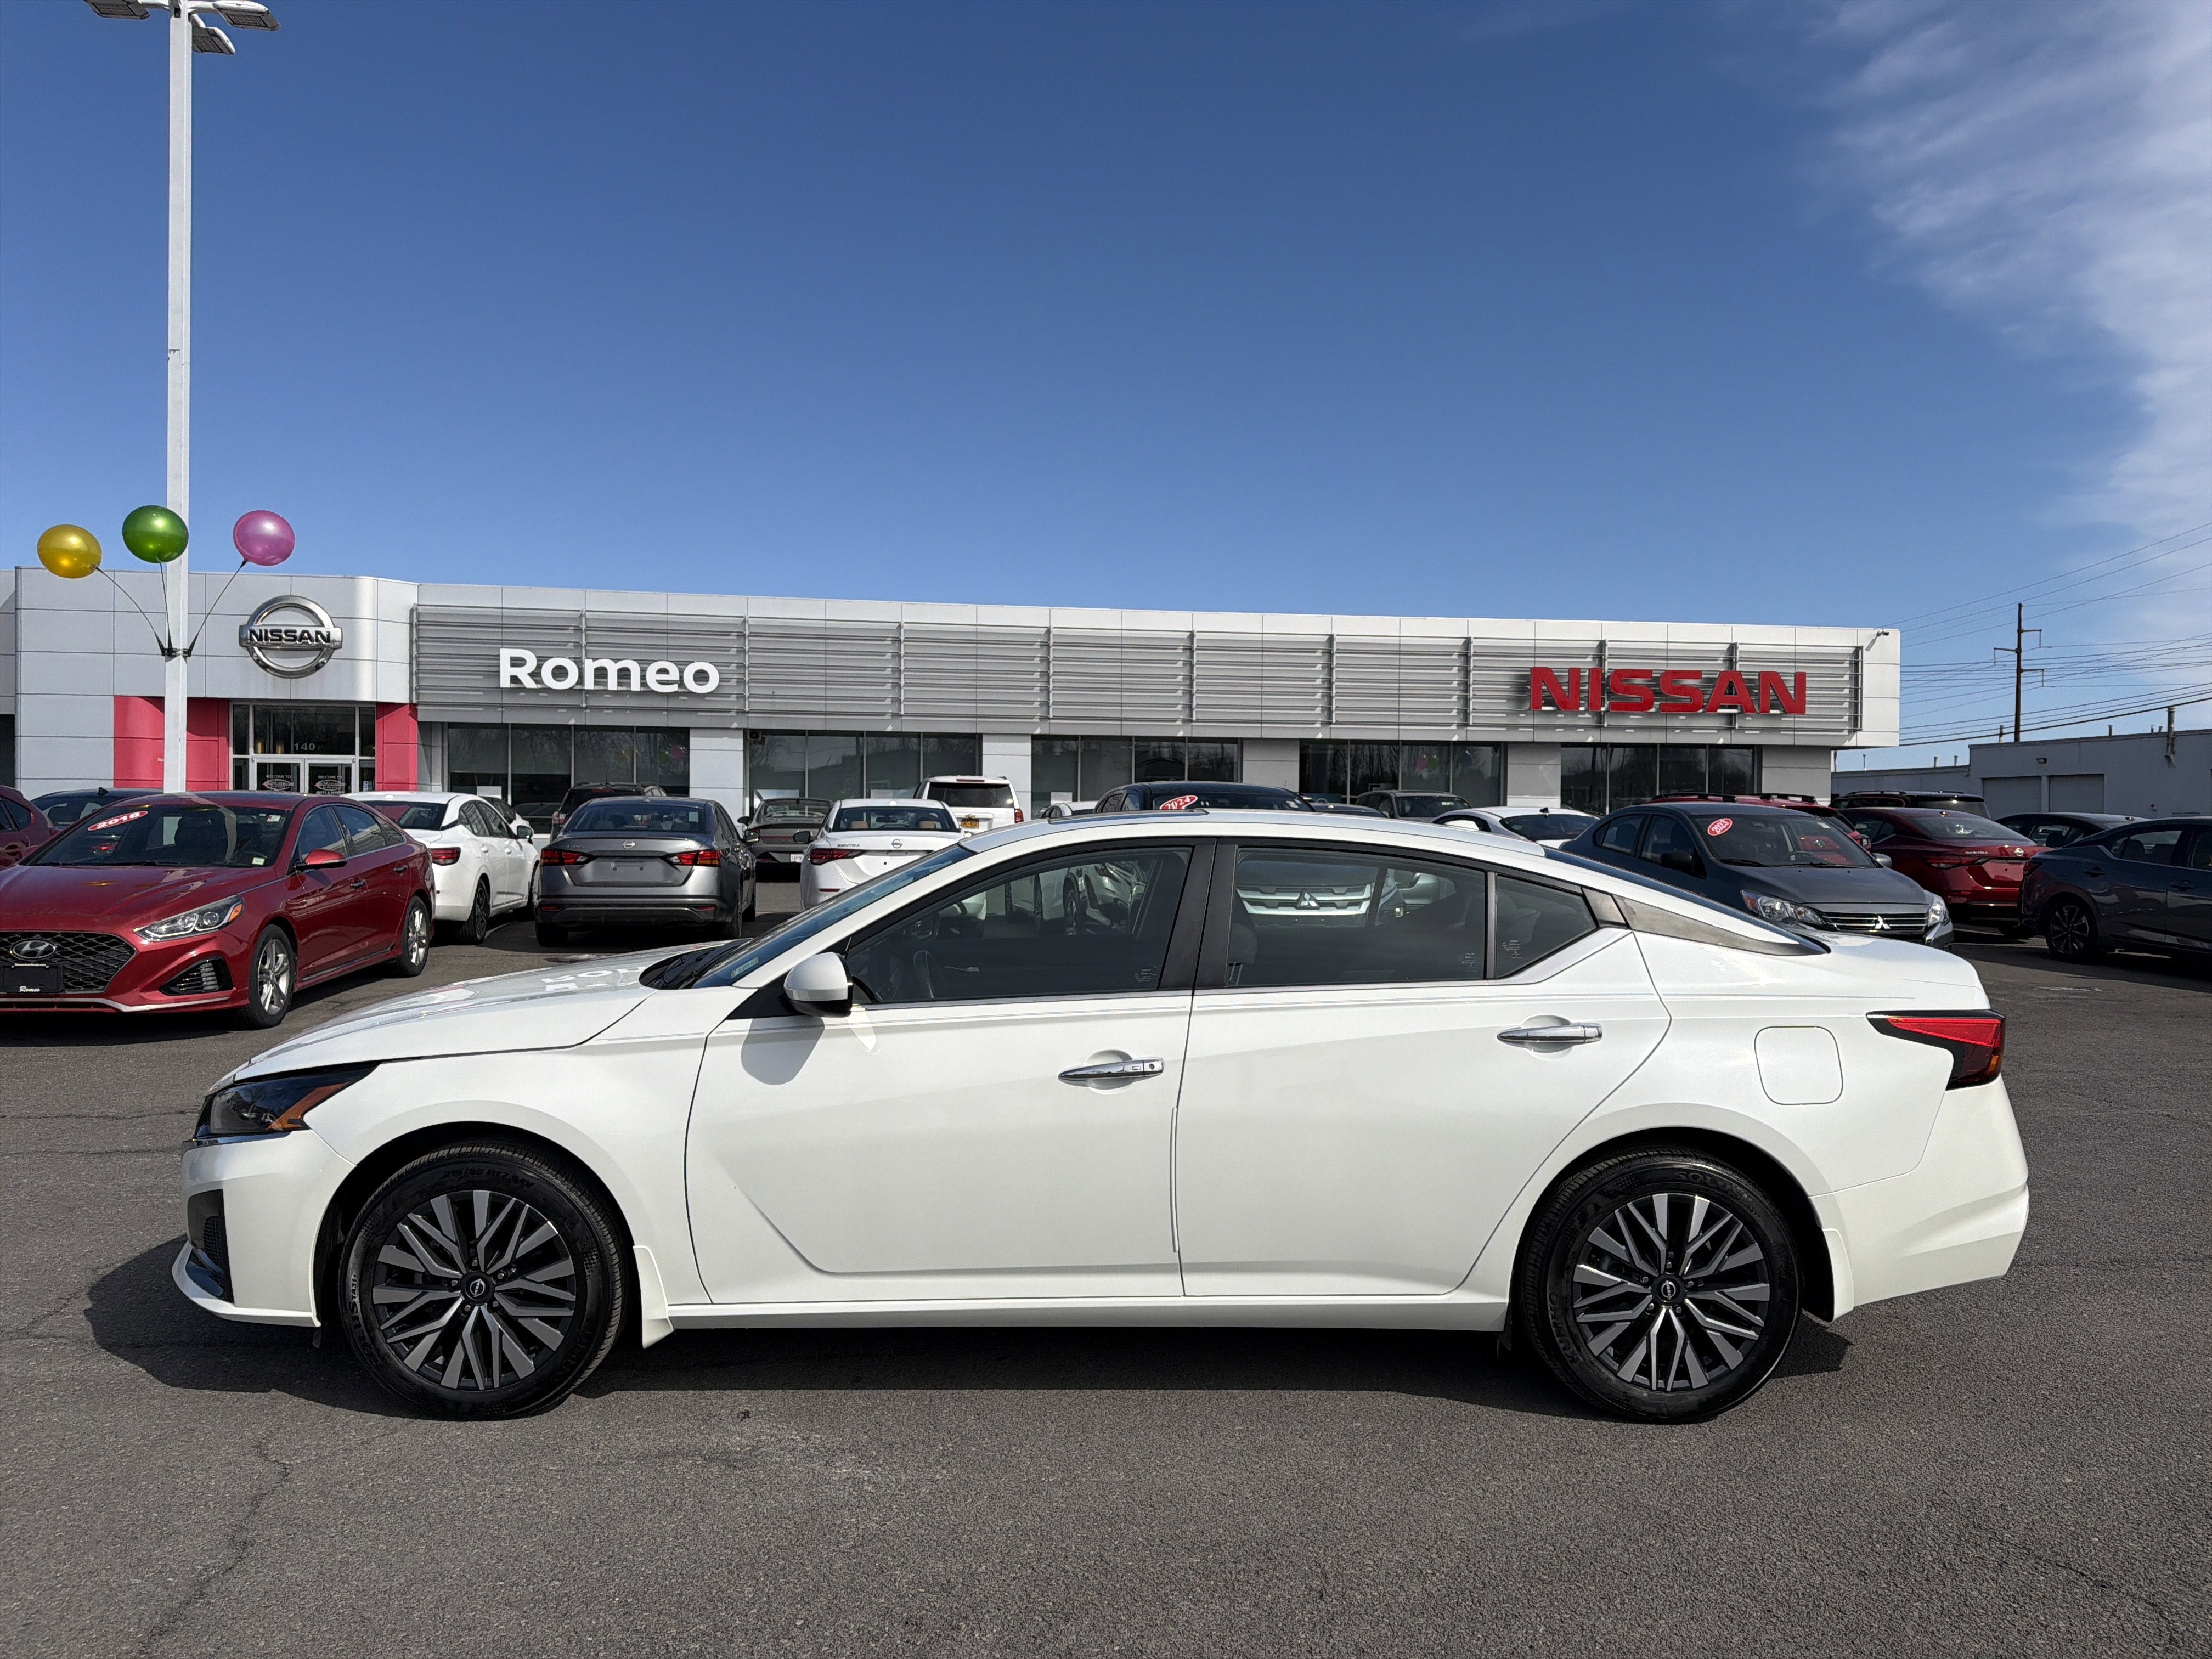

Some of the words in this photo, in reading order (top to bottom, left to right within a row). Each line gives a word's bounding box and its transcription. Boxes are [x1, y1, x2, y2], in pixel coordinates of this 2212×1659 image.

[249, 629, 331, 643] NISSAN
[499, 648, 720, 693] Romeo
[1530, 667, 1806, 714] NISSAN
[294, 742, 315, 751] 140
[1165, 796, 1190, 809] 2024
[97, 812, 140, 829] 2018
[1711, 820, 1729, 834] 2023
